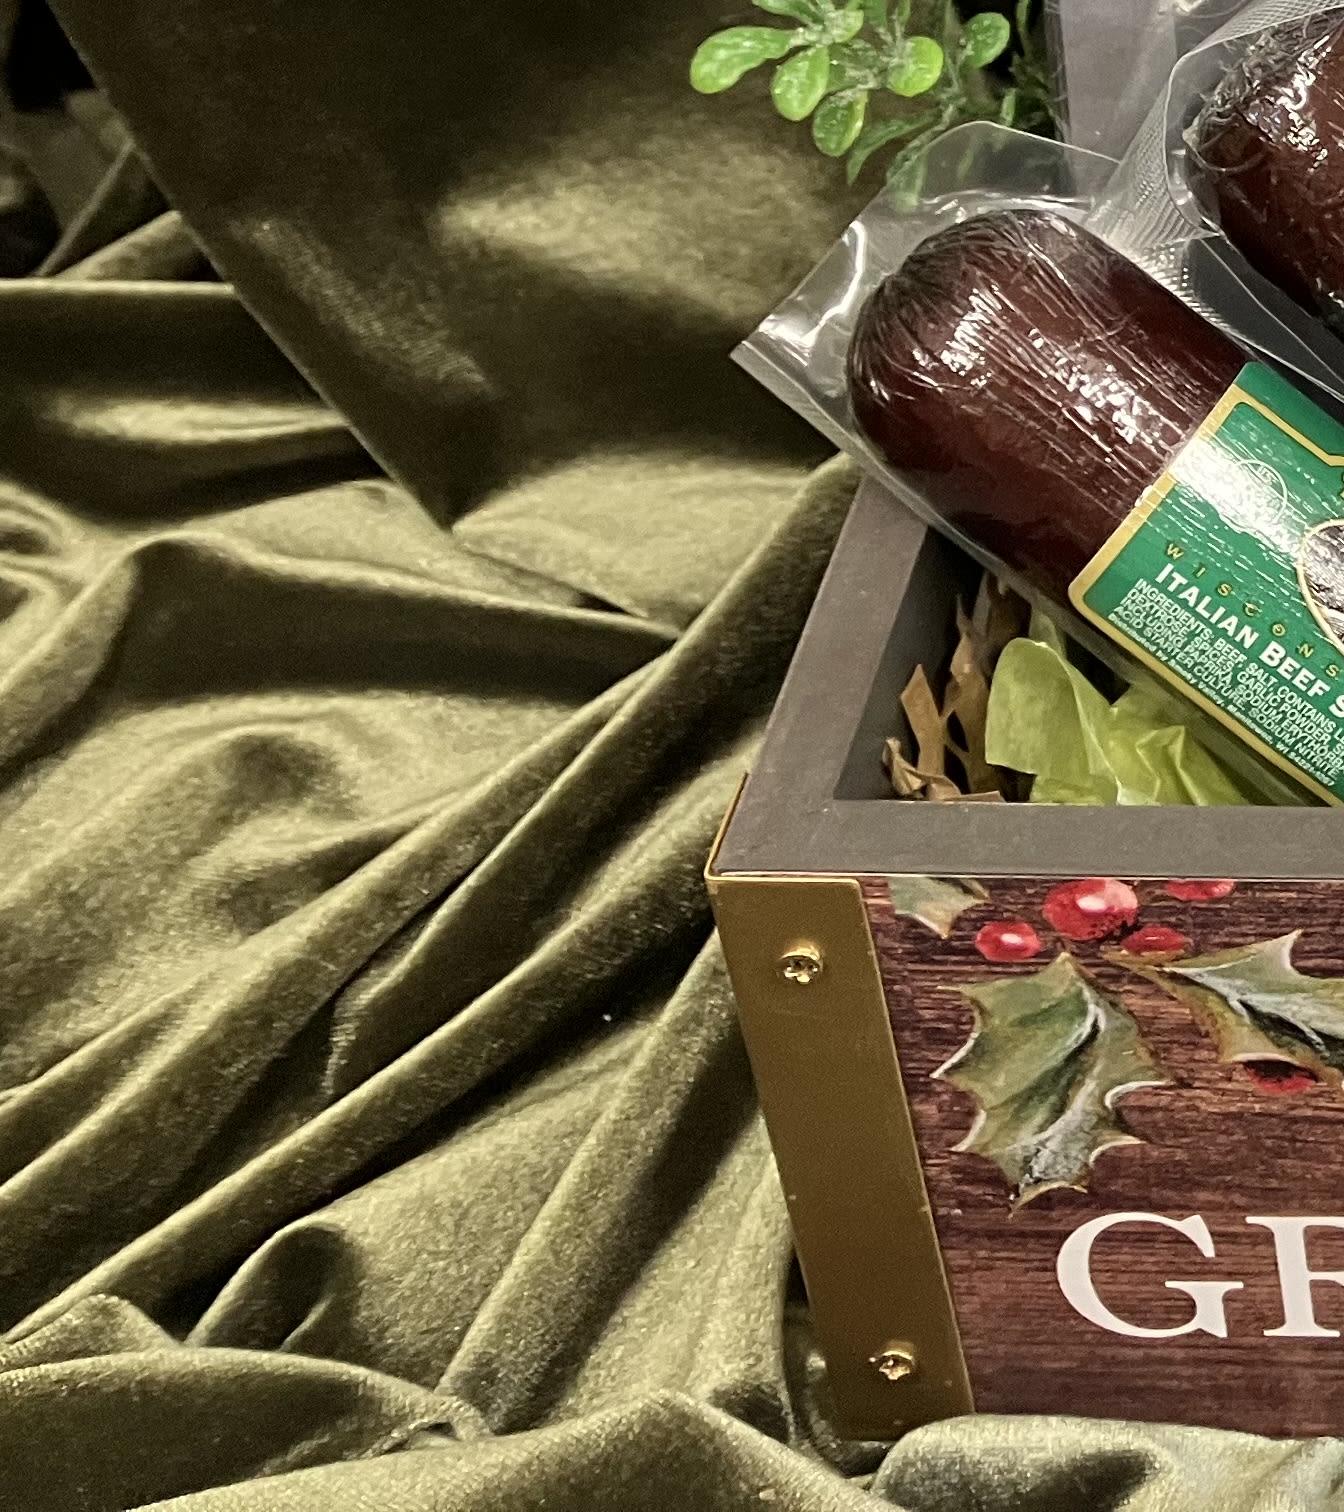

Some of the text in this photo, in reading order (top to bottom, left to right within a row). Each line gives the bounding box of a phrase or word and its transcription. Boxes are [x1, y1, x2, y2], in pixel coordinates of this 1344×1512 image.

[1112, 605, 1144, 629] ACID
[1142, 626, 1195, 668] STARTER
[1247, 706, 1297, 746] SODIUM
[1119, 596, 1186, 648] INCLUDING
[1180, 643, 1232, 688] PAPRIKA,
[1233, 683, 1283, 723] SODIUM
[1126, 587, 1191, 641] DEXTROSE,
[1189, 635, 1235, 673] SPICES,
[1235, 670, 1281, 707] GARLIC
[1277, 702, 1332, 749] POWDER,
[1134, 578, 1214, 643] INGREDIENTS:
[1276, 685, 1336, 733] CONTAINS
[1155, 563, 1259, 648] ITALIAN
[1259, 640, 1330, 696] BEEF
